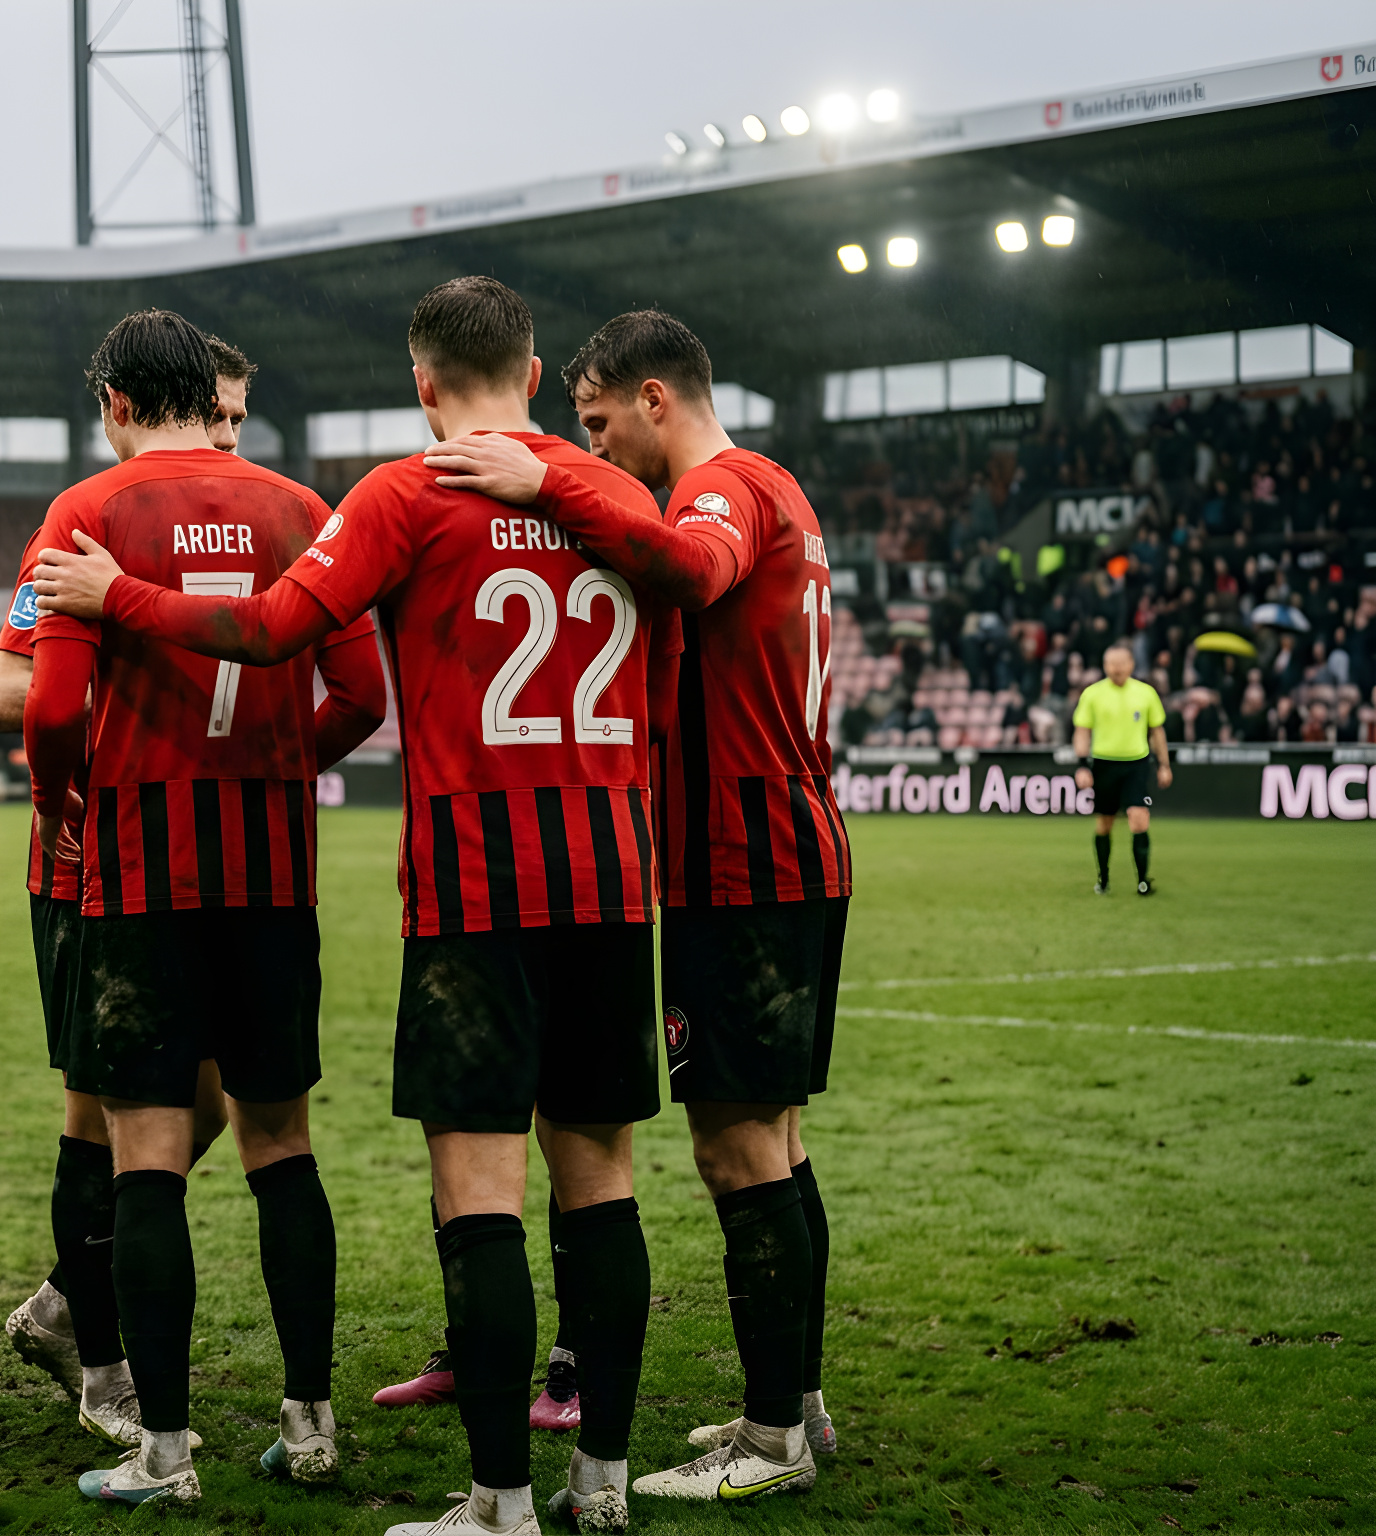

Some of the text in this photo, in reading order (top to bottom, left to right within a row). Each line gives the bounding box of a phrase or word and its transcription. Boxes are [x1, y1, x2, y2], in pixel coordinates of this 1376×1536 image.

[173, 523, 255, 555] ARDER
[490, 517, 583, 551] GERU
[181, 572, 255, 737] 7
[475, 568, 636, 745] 22
[1260, 764, 1376, 820] MC
